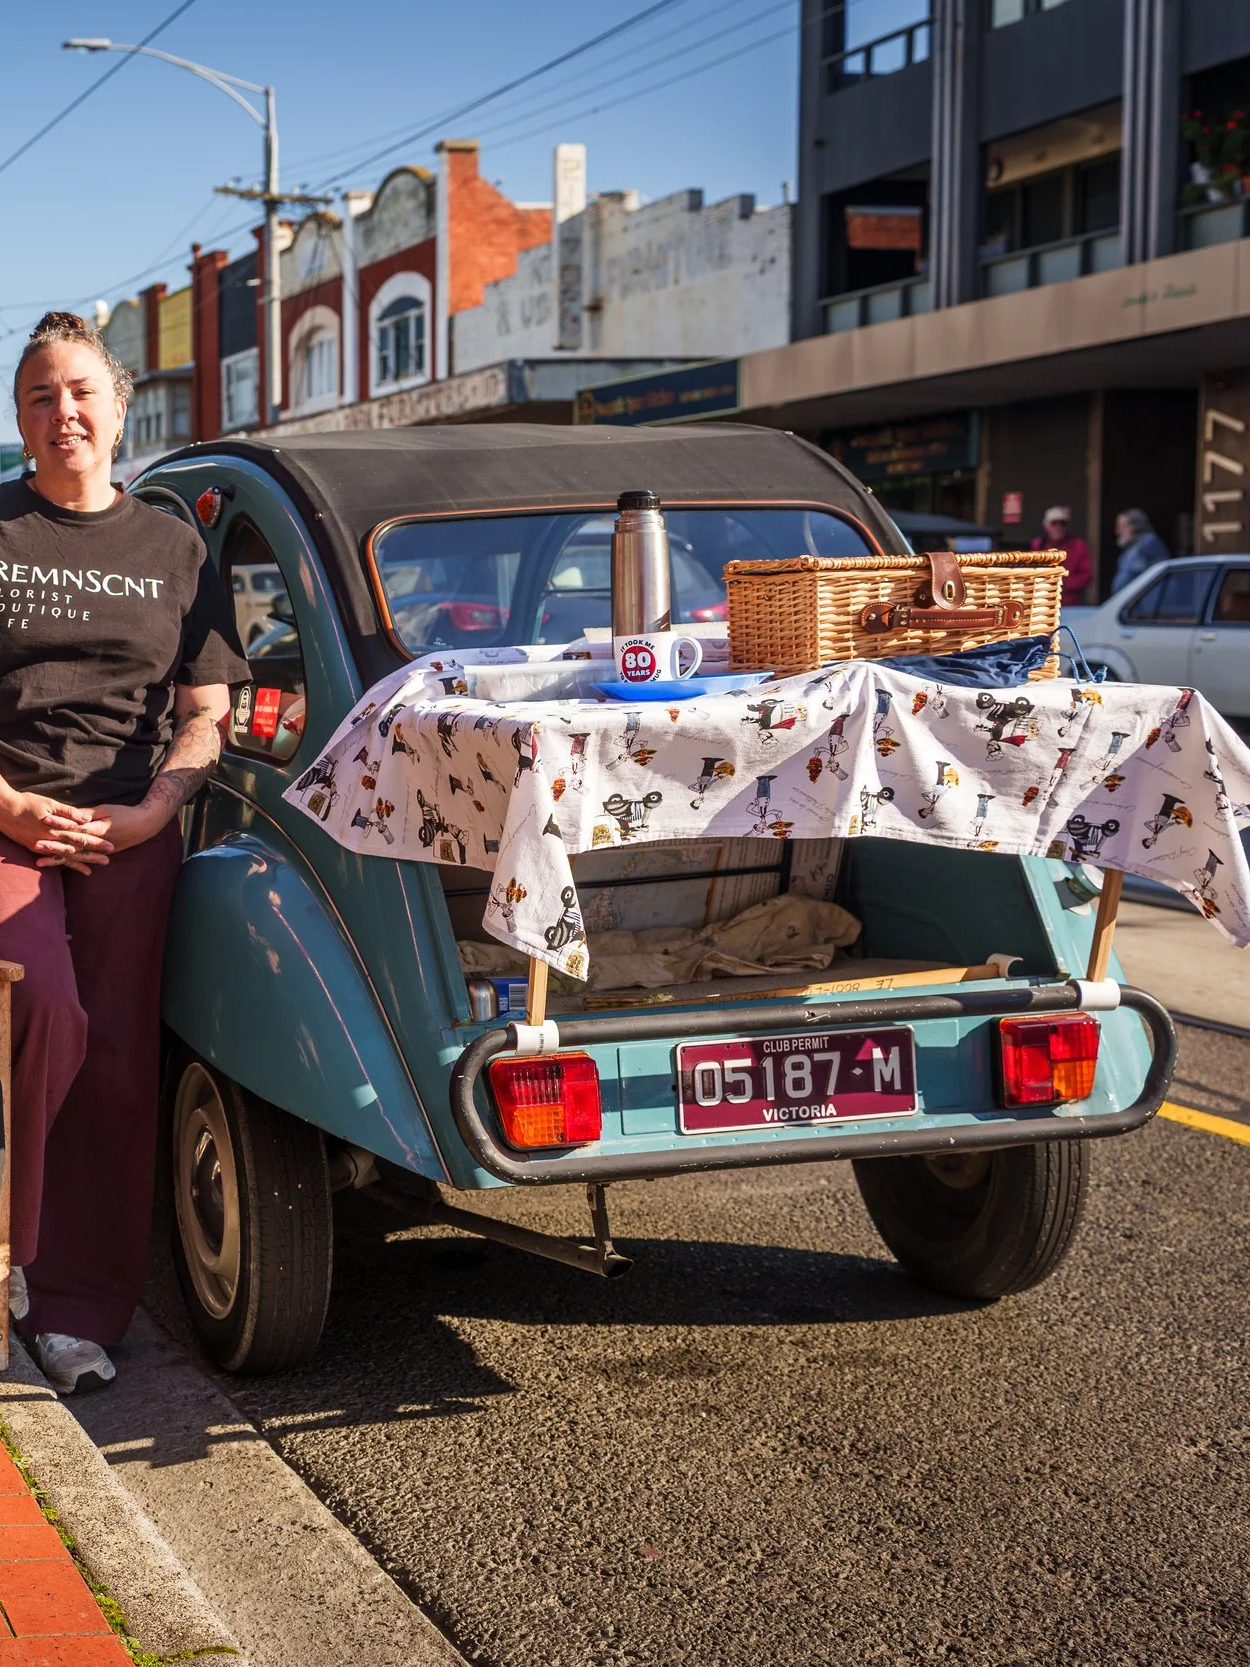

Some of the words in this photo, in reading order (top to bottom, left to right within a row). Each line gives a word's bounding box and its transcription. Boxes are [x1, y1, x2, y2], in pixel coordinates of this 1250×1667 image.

[1202, 408, 1246, 542] 1177
[625, 639, 644, 647] TOOK
[645, 641, 655, 650] ME
[625, 651, 652, 668] 80
[627, 669, 651, 677] YEARS
[763, 1040, 790, 1053] CLUB
[792, 1037, 830, 1051] PERMIT
[694, 1051, 841, 1107] 05187
[871, 1046, 902, 1092] M
[762, 1103, 838, 1122] VICTORIA
